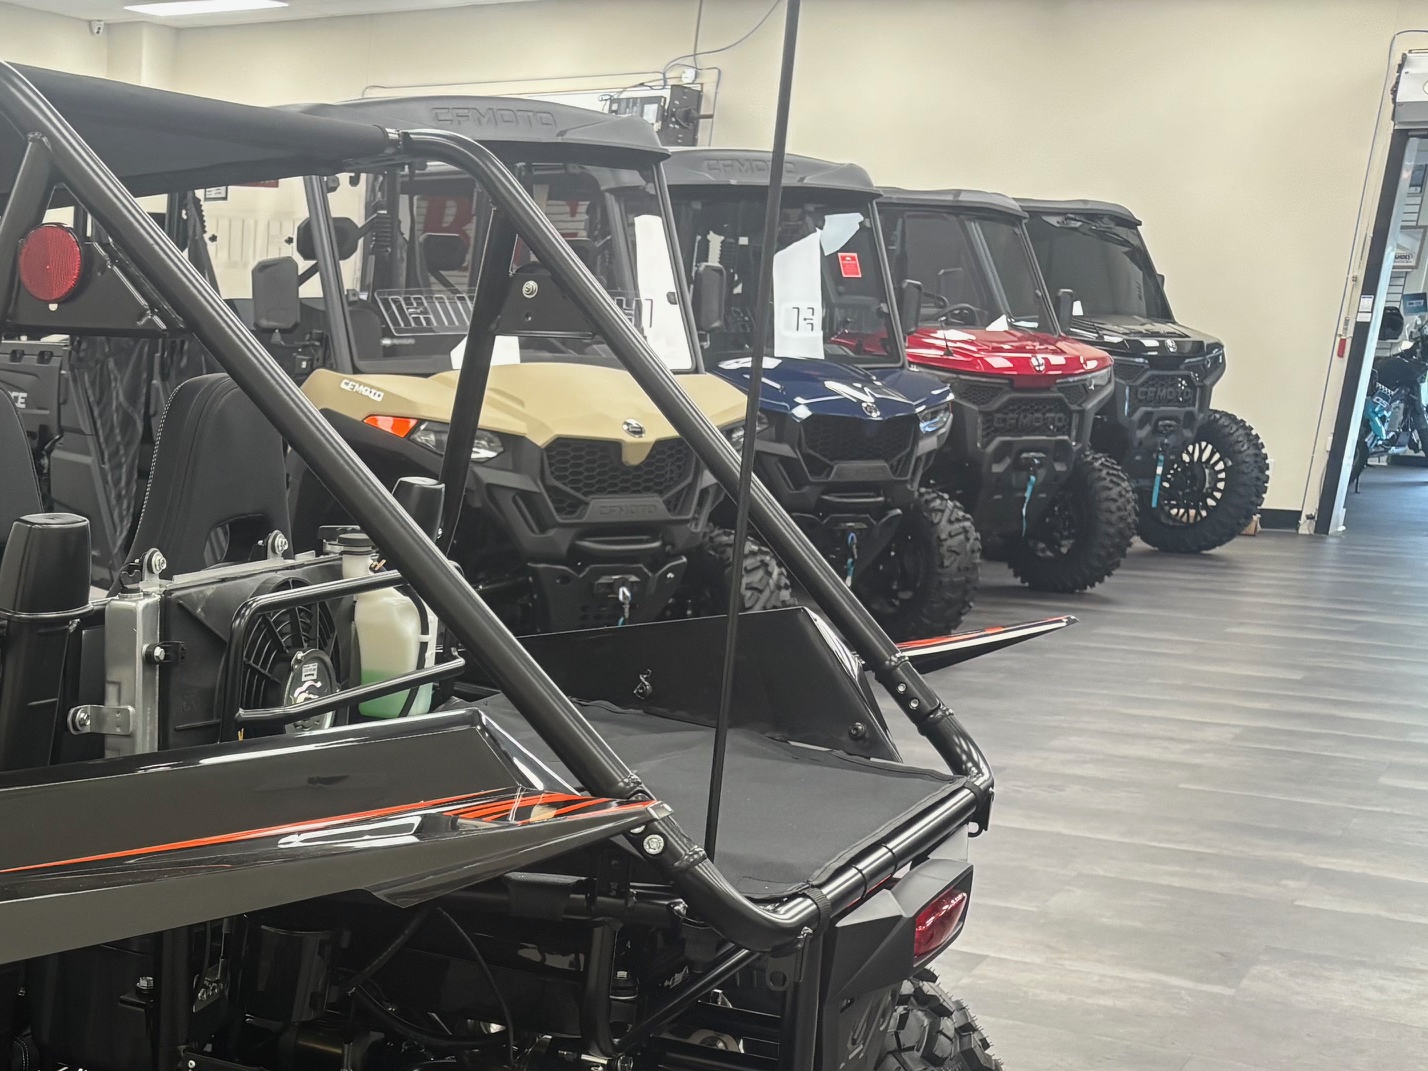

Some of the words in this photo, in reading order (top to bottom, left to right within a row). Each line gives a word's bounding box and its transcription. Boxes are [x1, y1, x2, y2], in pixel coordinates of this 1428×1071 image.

[431, 107, 557, 128] CFMOTO
[703, 158, 796, 174] CFMOO
[340, 379, 384, 402] CFMOTO
[1137, 386, 1193, 401] CFMOTO
[992, 413, 1069, 428] CFMOTO
